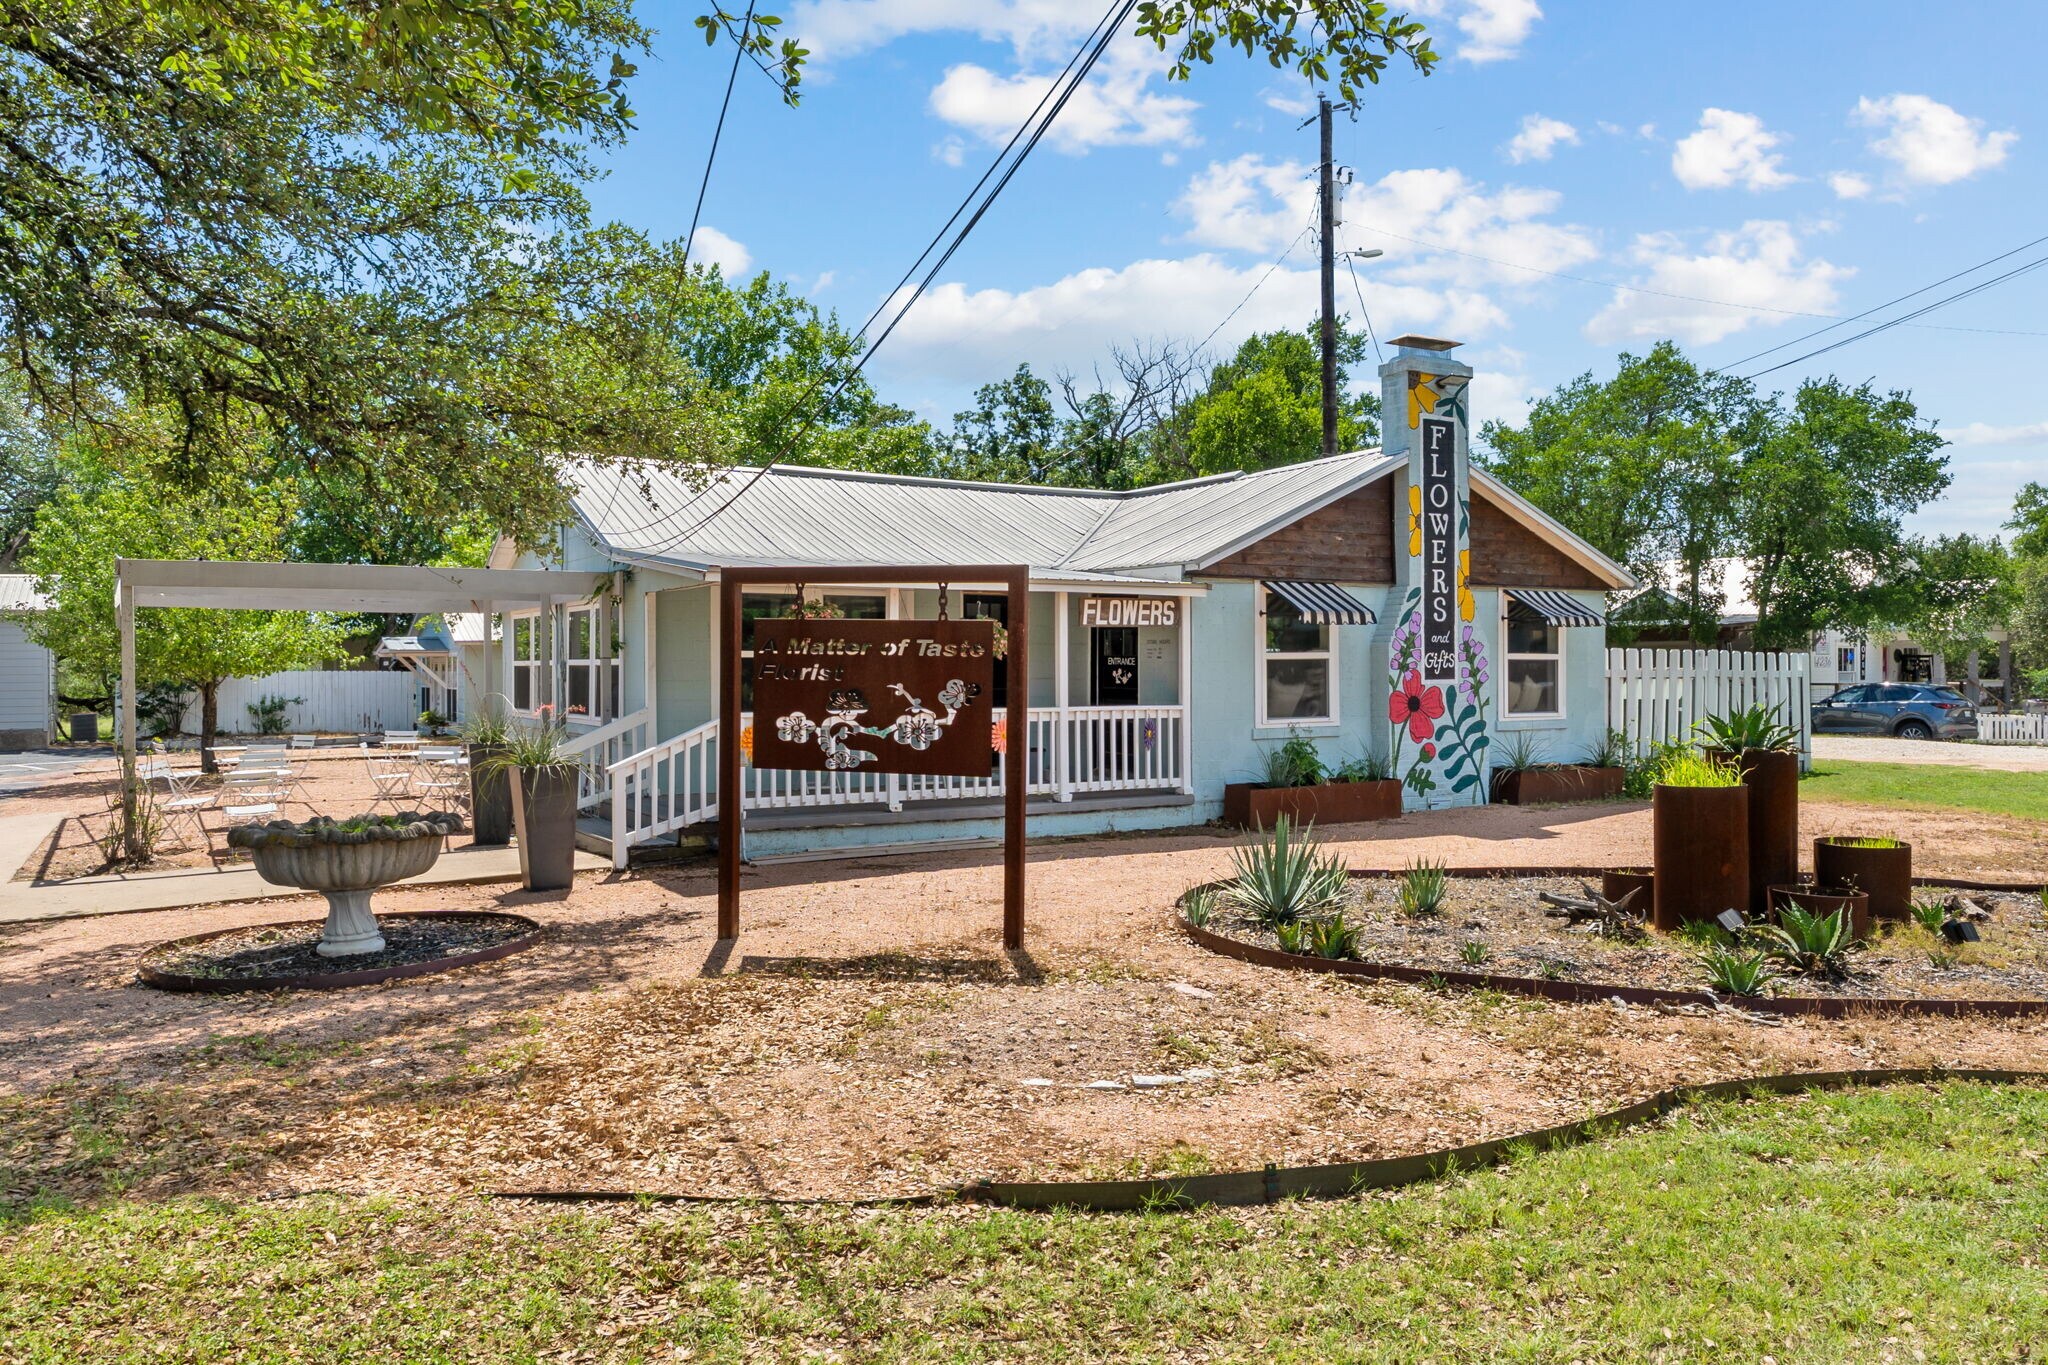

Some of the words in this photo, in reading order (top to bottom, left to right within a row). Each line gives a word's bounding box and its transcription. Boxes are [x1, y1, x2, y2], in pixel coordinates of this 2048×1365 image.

[1429, 425, 1449, 622] FLOWERS
[1082, 599, 1175, 626] FLOWERS
[758, 638, 778, 655] A
[786, 637, 872, 656] Matter
[880, 638, 911, 657] of
[916, 639, 985, 658] Taste
[1431, 630, 1451, 644] and
[1107, 657, 1136, 666] ENTRANCE
[1425, 650, 1455, 675] Gifts
[757, 663, 845, 682] Florist
